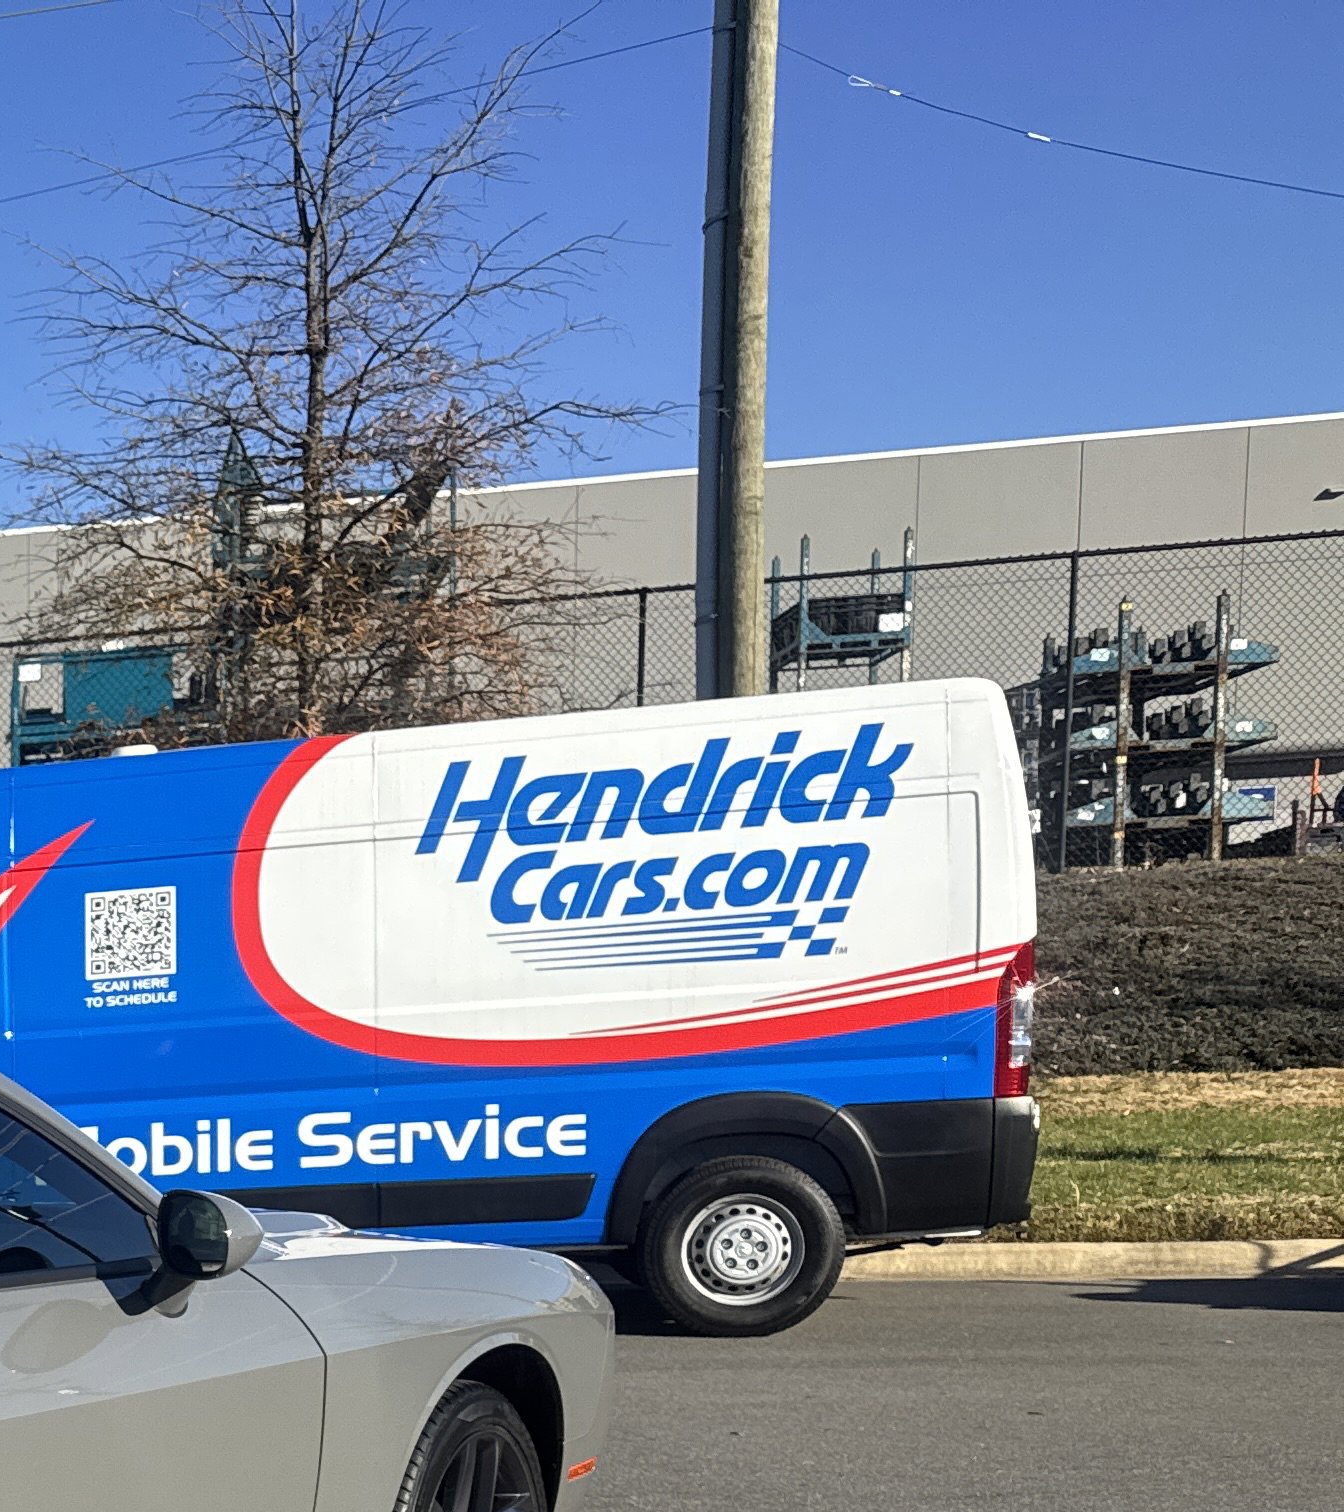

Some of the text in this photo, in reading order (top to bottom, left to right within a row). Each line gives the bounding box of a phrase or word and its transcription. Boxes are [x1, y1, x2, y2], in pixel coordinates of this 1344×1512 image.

[414, 723, 914, 883] Hendrick
[490, 842, 870, 924] Cars.com
[834, 946, 848, 955] TM
[83, 991, 177, 1008] TO SCHEDULE
[92, 977, 169, 993] SCAN HERE
[79, 1104, 587, 1176] obile Service
